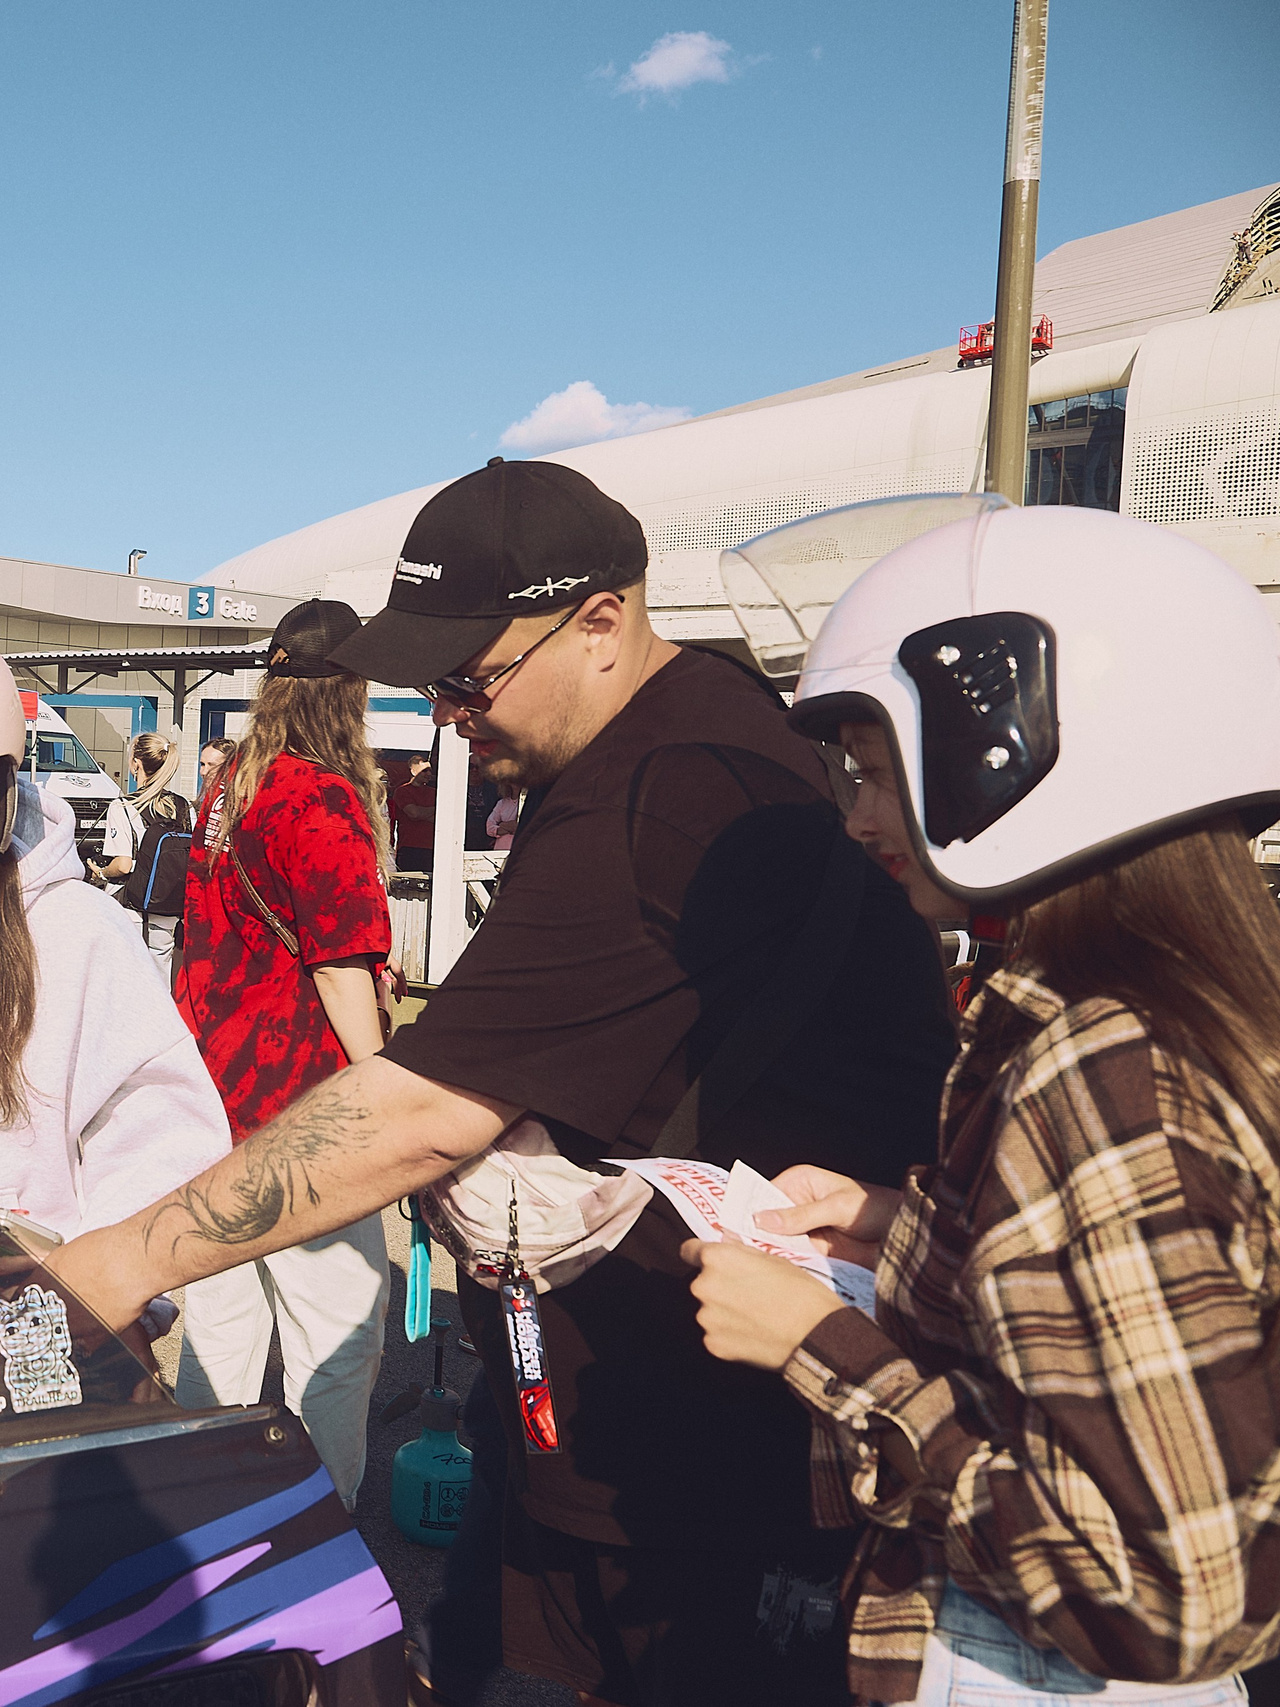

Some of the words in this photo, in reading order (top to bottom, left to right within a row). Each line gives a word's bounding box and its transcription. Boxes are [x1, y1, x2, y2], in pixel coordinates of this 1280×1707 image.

[138, 585, 183, 617] Вход
[195, 592, 210, 615] 3
[220, 596, 258, 622] Gate
